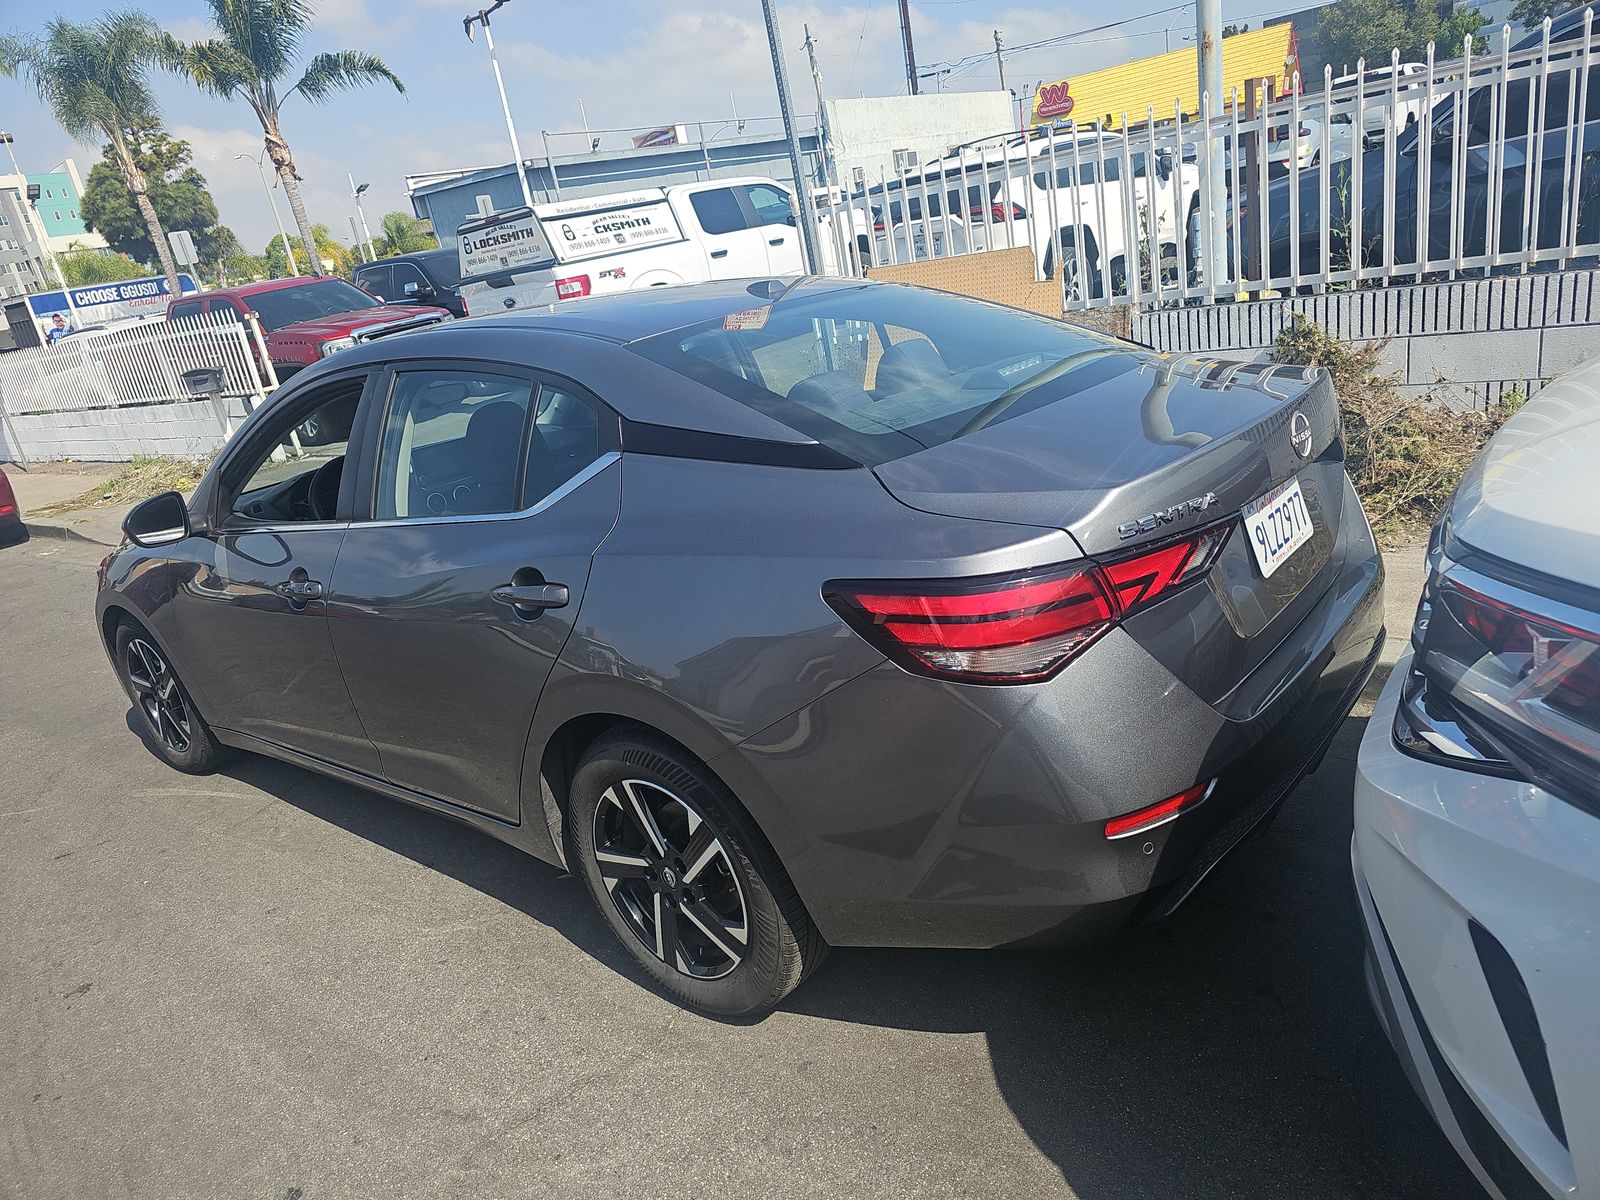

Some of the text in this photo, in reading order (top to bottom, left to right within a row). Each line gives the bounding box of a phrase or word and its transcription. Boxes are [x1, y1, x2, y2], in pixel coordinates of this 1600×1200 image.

[556, 204, 591, 214] Residential
[473, 227, 534, 250] LOCKSMITH
[75, 281, 160, 306] CHOOSE GGUSD!
[128, 294, 174, 308] Enroll No
[1117, 491, 1219, 540] SENTRA
[1255, 491, 1307, 563] 9LZZ977
